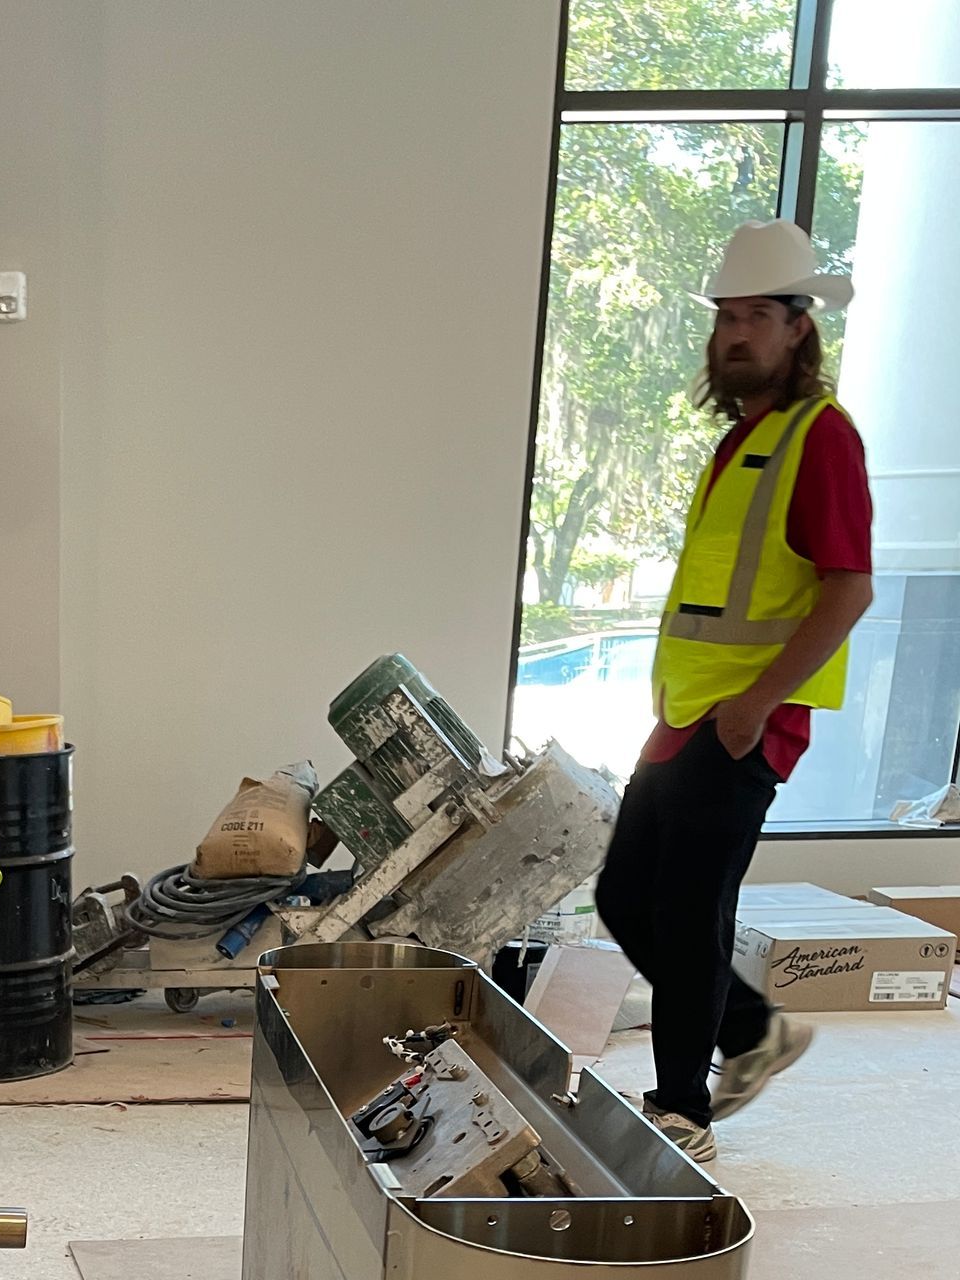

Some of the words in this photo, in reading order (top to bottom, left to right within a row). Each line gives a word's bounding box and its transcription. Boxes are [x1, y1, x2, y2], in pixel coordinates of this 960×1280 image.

[221, 822, 245, 832] CODE
[247, 822, 264, 832] 211
[771, 945, 862, 968] American
[774, 956, 864, 988] Standard
